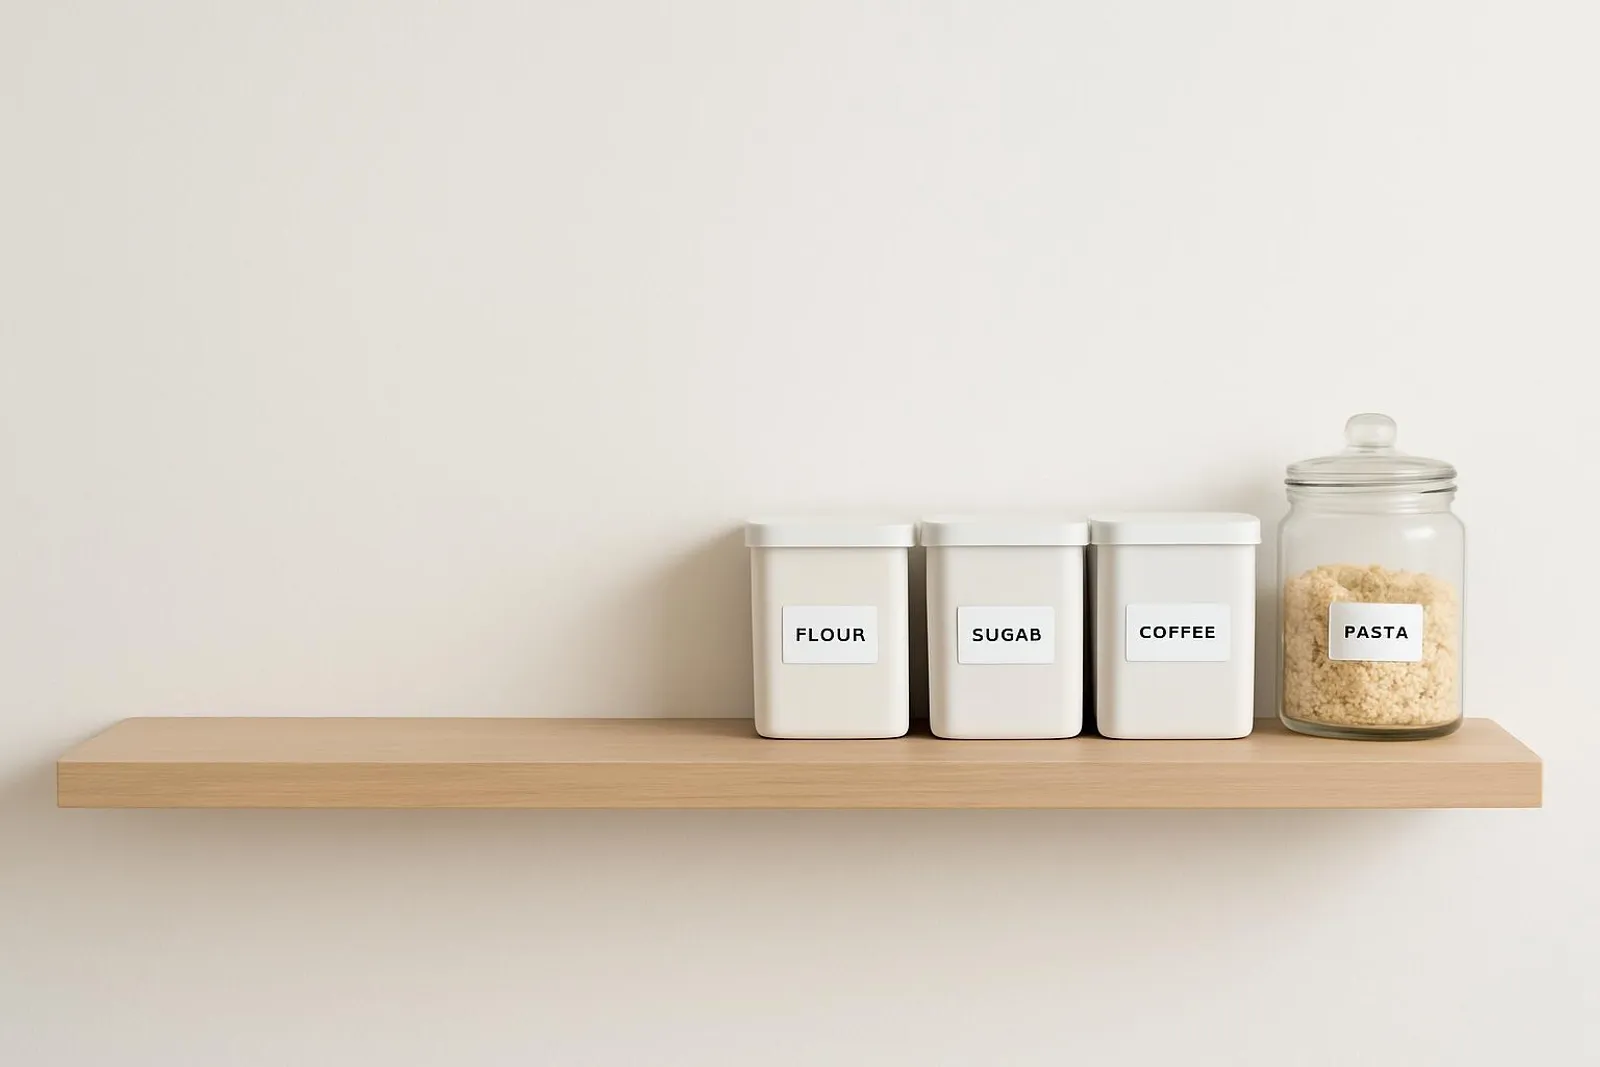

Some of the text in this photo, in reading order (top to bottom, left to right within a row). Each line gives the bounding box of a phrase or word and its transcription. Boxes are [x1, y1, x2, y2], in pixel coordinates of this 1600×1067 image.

[796, 627, 866, 642] FLOUR
[972, 627, 1042, 642] SUGAB
[1139, 625, 1216, 639] COFFEE
[1344, 625, 1409, 639] PASTA
